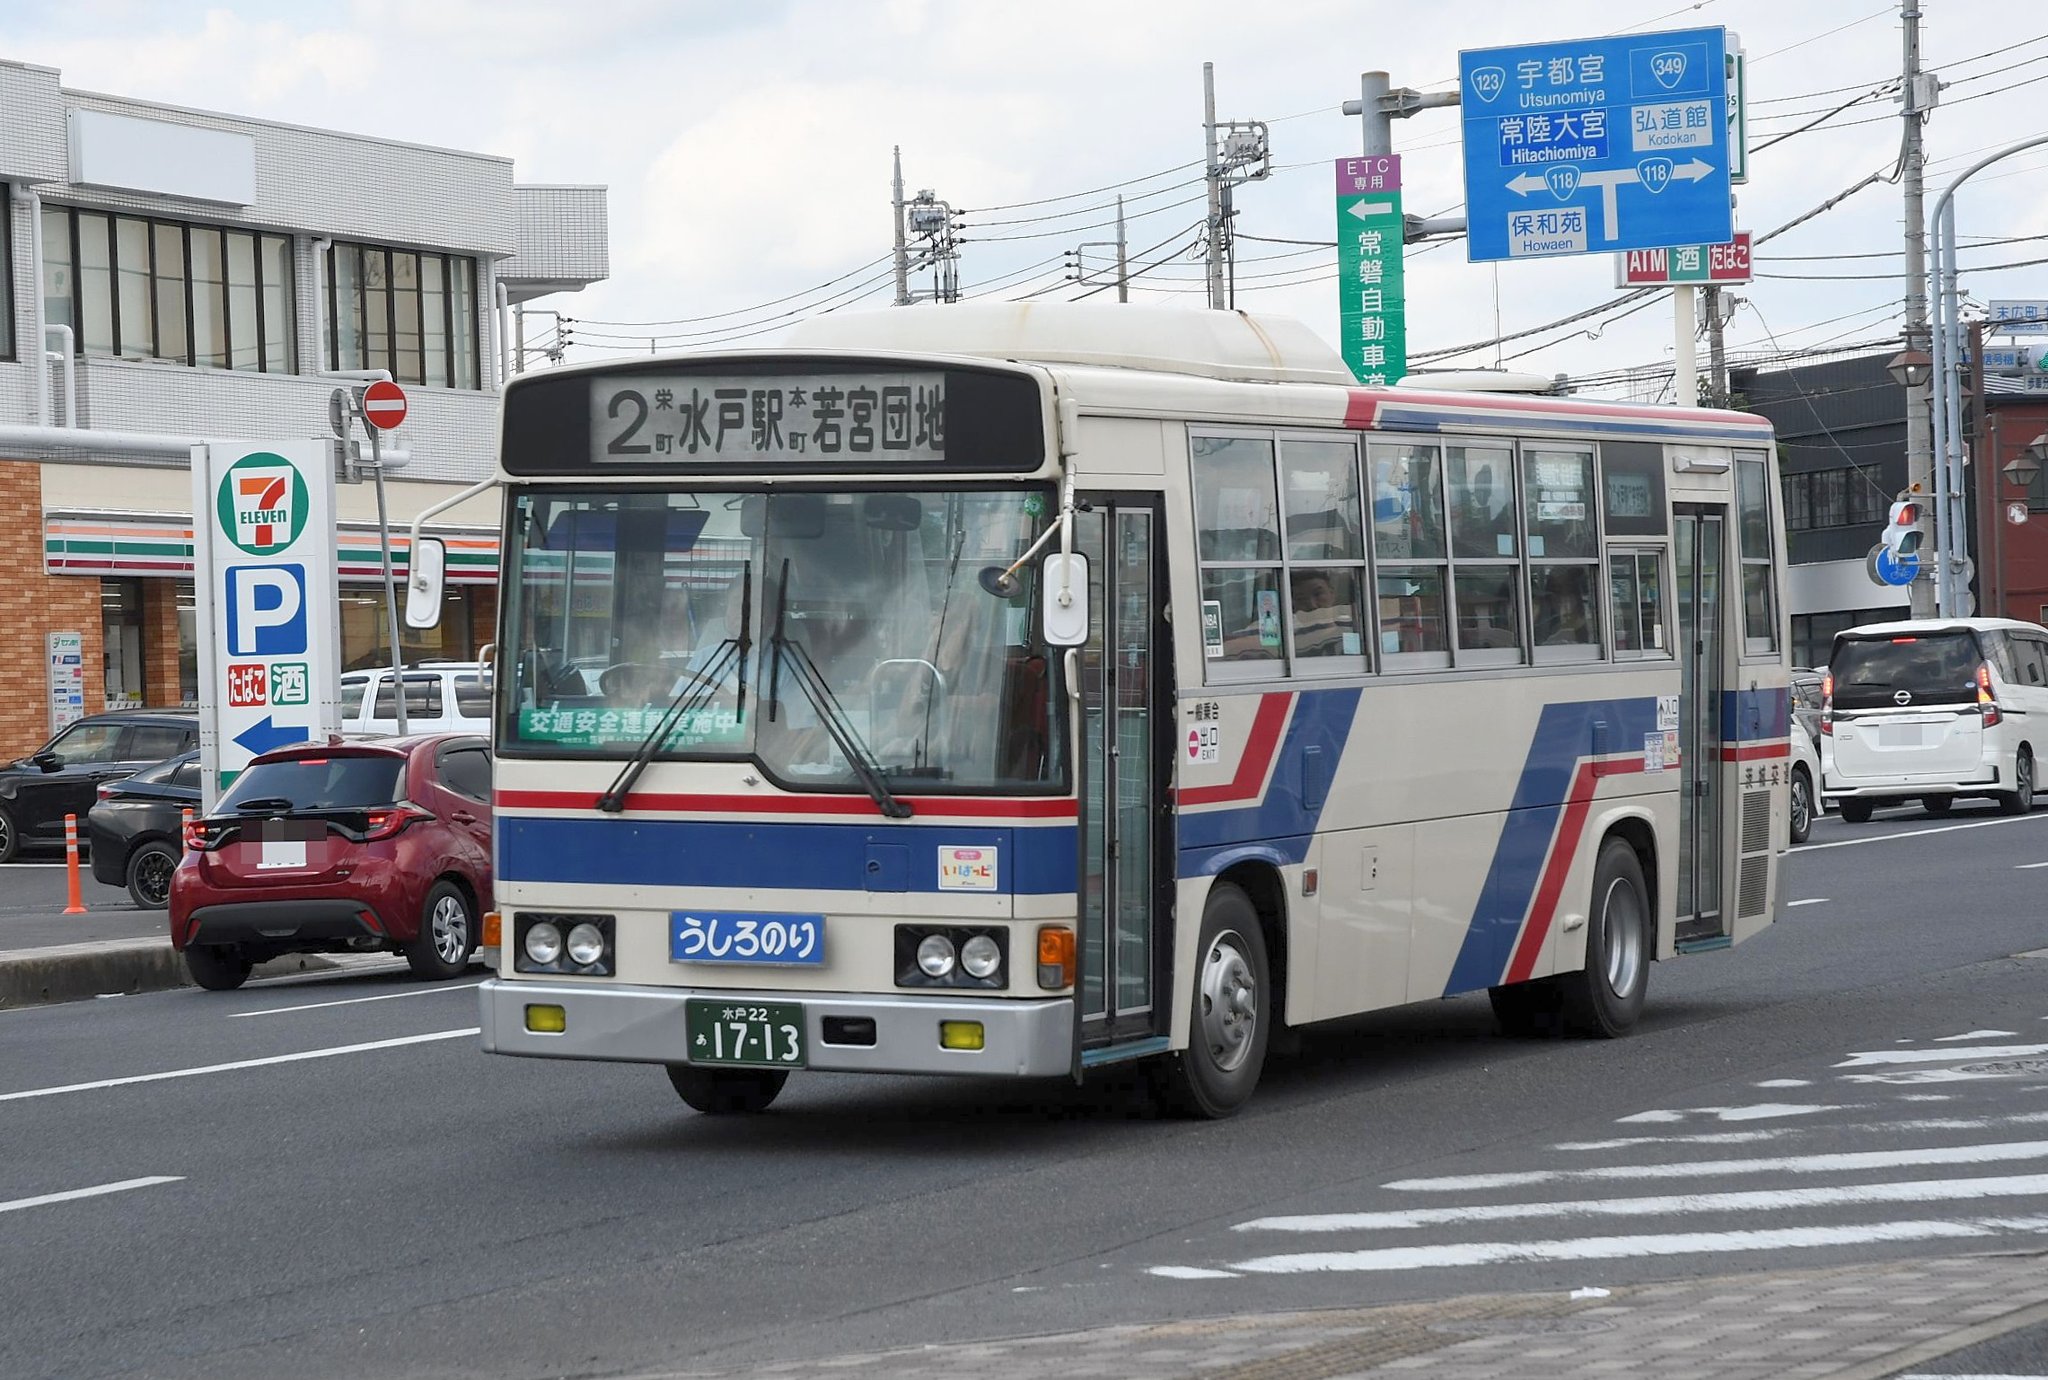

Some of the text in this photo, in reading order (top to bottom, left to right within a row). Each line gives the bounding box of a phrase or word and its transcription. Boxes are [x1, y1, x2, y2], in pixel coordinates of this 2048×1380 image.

[1517, 54, 1605, 89] 宇都宮
[1656, 57, 1683, 76] 349
[1476, 73, 1500, 91] 123
[1519, 88, 1606, 109] Utsunomiya
[1500, 110, 1606, 146] 常陸大宮
[1636, 106, 1708, 133] 弘道館
[1648, 132, 1697, 146] Kodokan
[1511, 144, 1597, 164] Hitachiomiya
[1346, 158, 1390, 175] ETC
[1644, 164, 1667, 182] 118
[1354, 175, 1384, 191] 専用
[1551, 172, 1574, 188] 118
[1512, 211, 1582, 237] 保和苑
[1523, 238, 1573, 252] Howaen
[1629, 248, 1666, 273] ATM
[1675, 245, 1701, 272] 酒
[1710, 245, 1749, 271] たばこ
[607, 388, 652, 455] 2
[678, 387, 785, 455] 水戸駅
[812, 384, 945, 454] 若宮団地
[240, 509, 287, 524] ELEVEN
[235, 568, 301, 654] P
[228, 666, 266, 704] たばこ
[272, 665, 308, 703] 酒
[529, 711, 738, 735] 交通安全運動実施中
[1200, 726, 1218, 747] 出口
[1202, 748, 1217, 761] EXIT
[679, 916, 816, 959] うしろのり
[695, 1021, 800, 1061] あ 17-13
